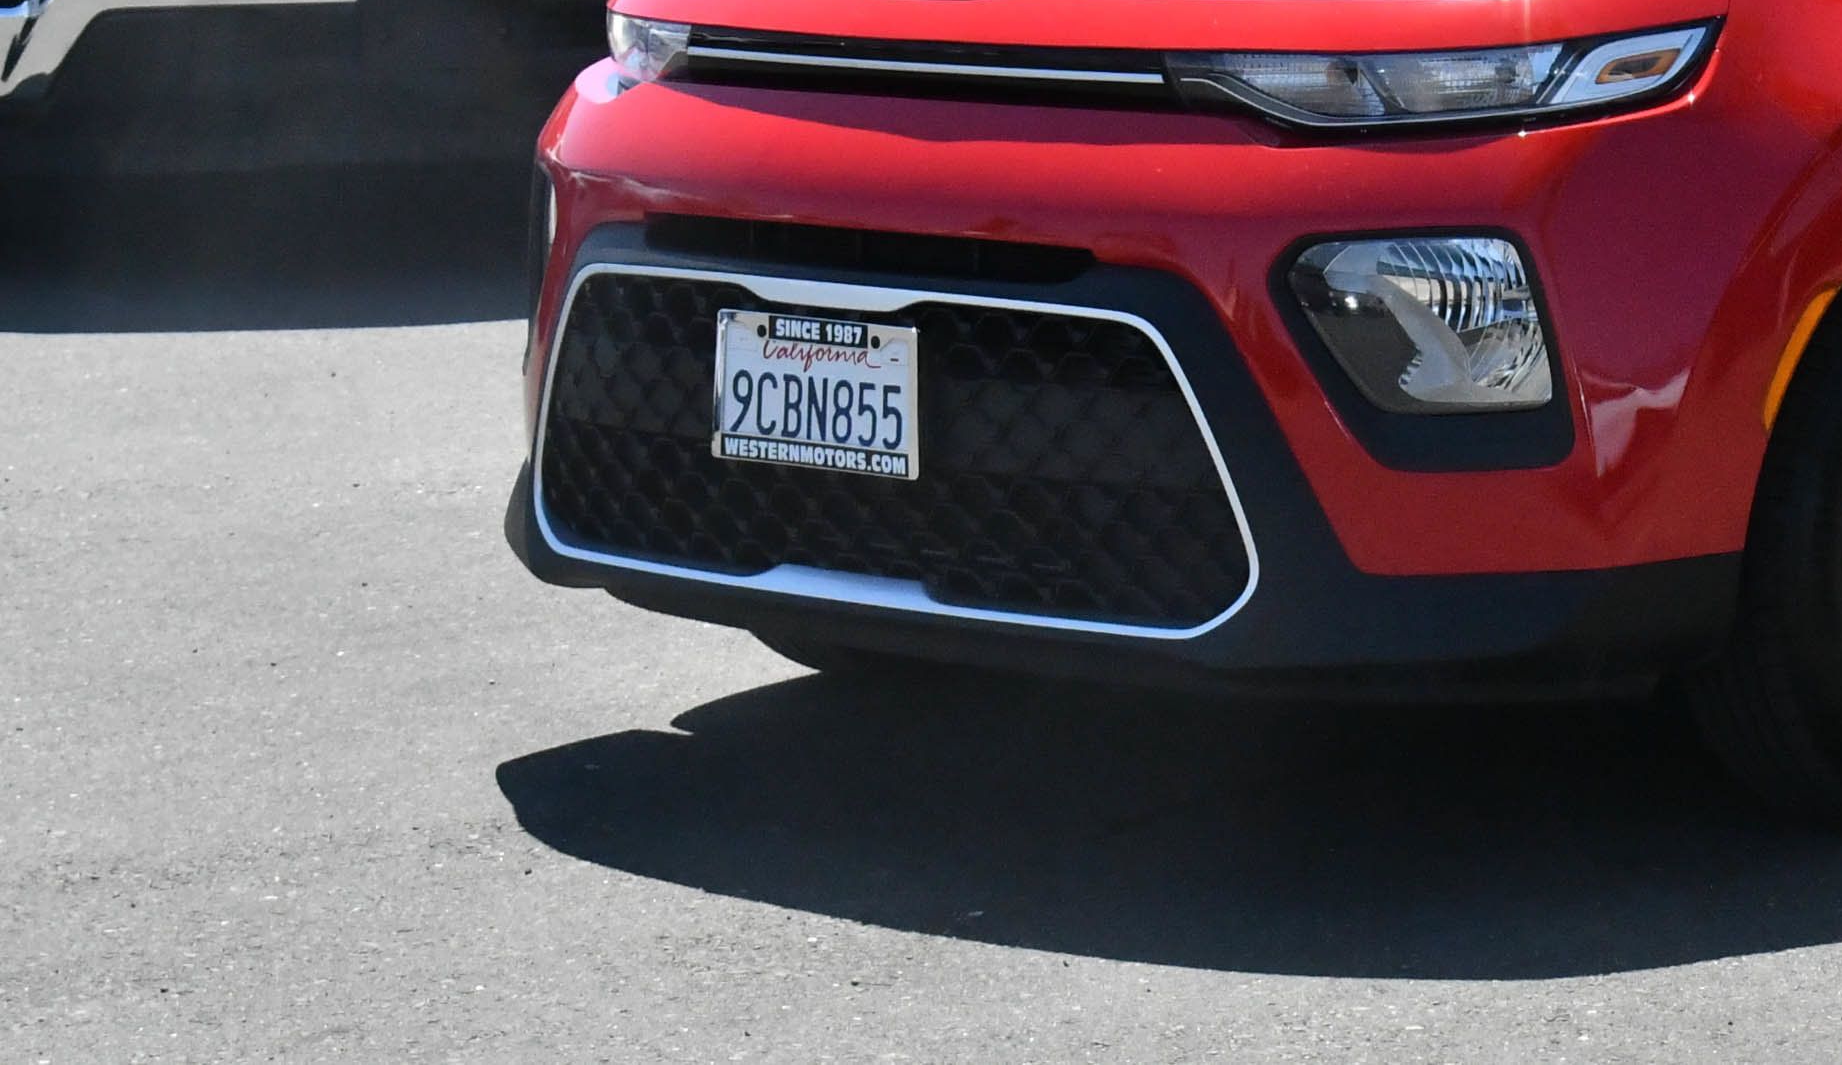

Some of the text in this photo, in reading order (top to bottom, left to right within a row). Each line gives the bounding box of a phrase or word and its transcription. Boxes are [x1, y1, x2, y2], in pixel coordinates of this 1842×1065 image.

[775, 318, 863, 345] SINCE 1987
[763, 340, 881, 372] California
[729, 369, 903, 450] 9CBN855
[724, 437, 906, 476] WESTERNMOTORS.COM
